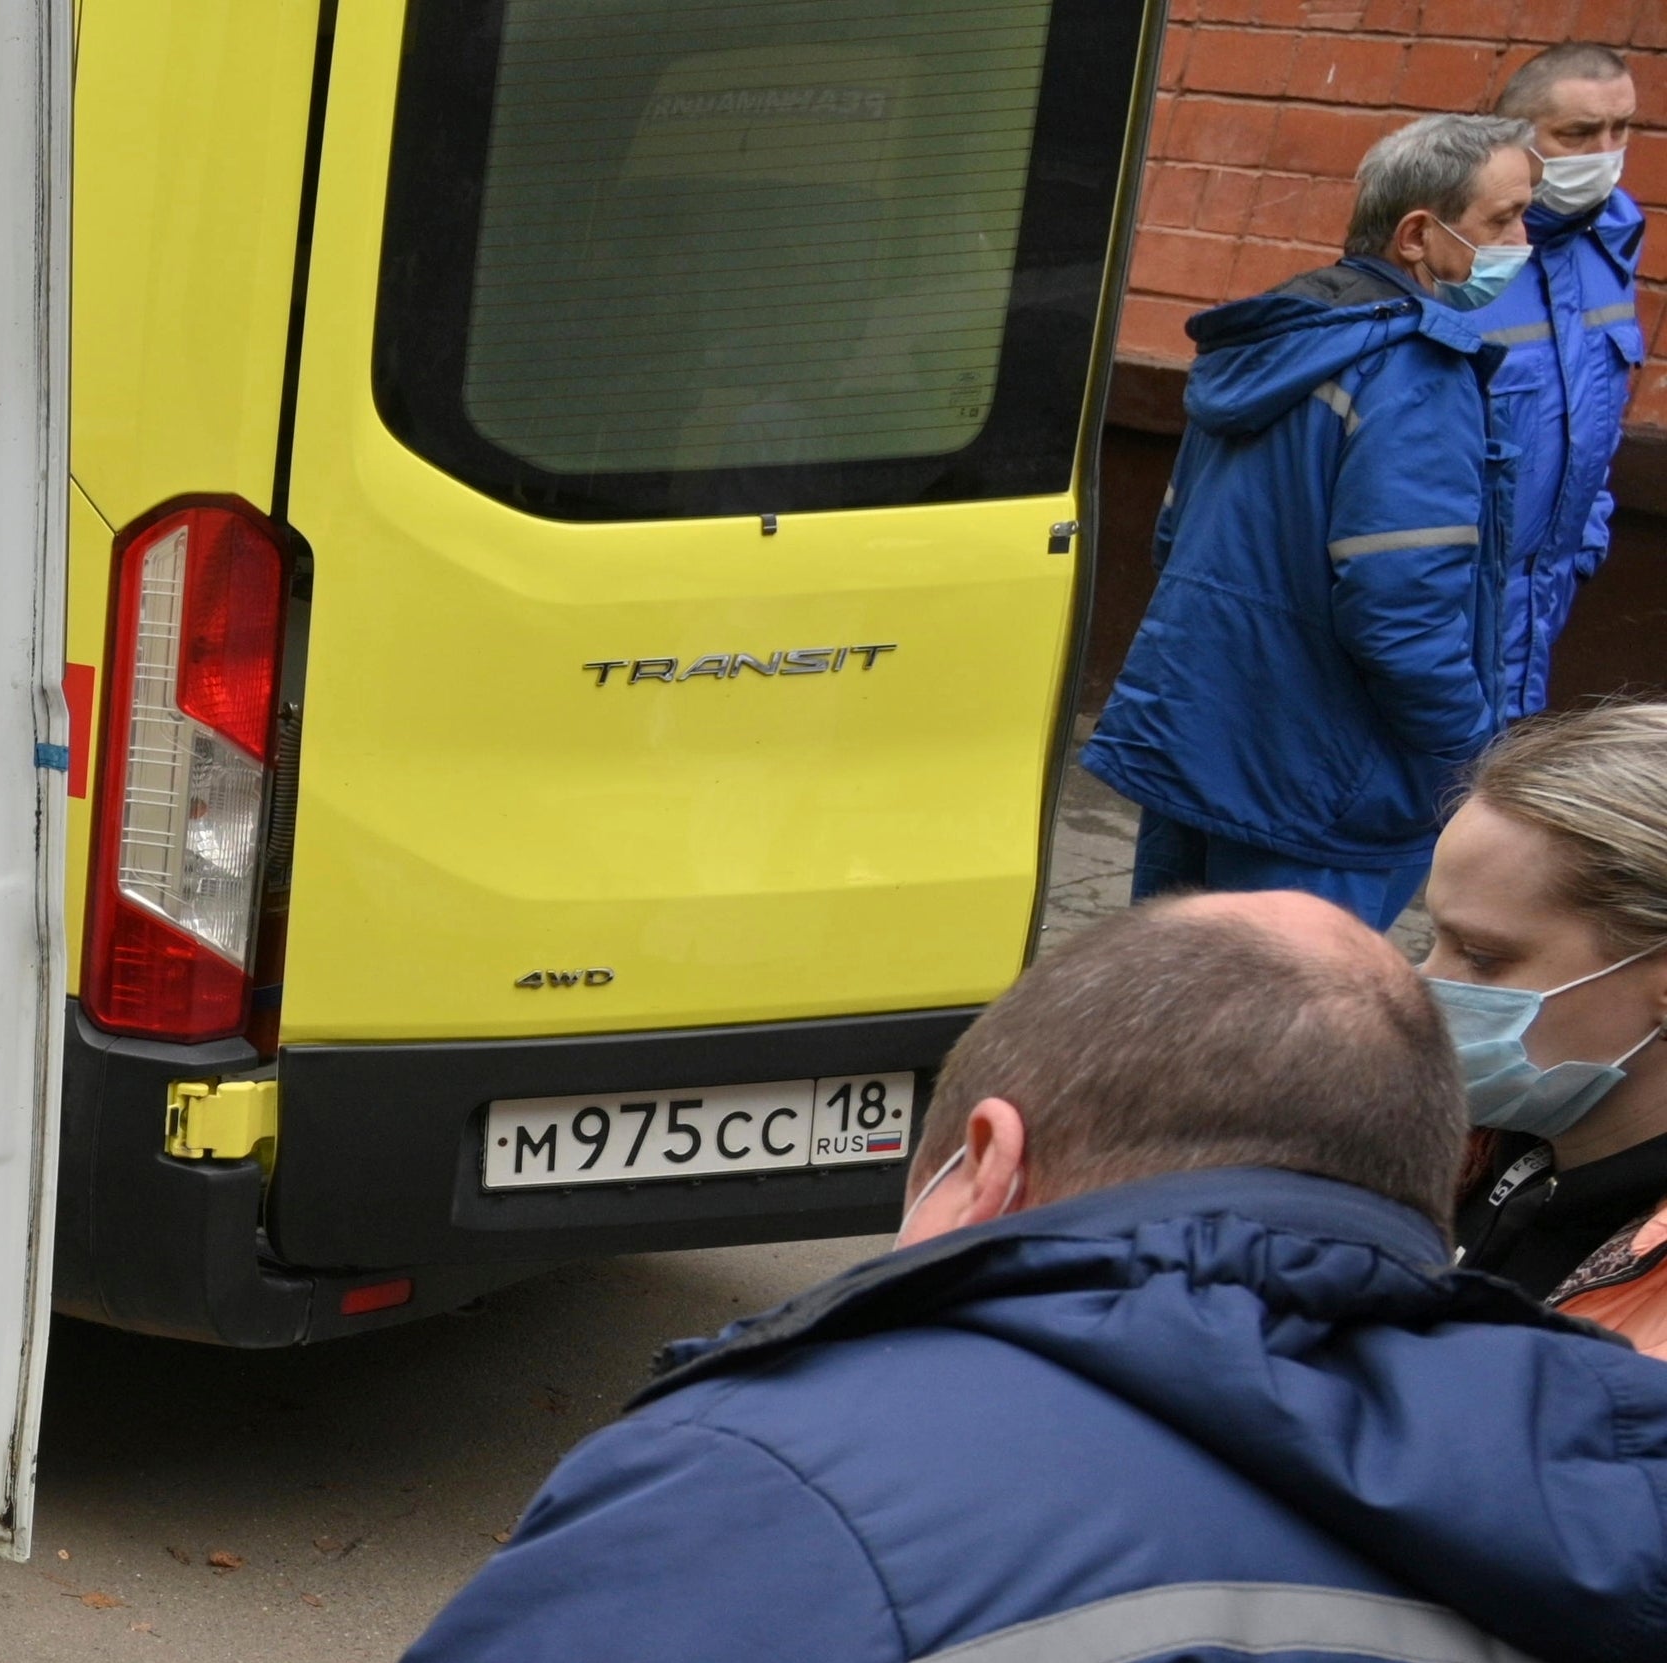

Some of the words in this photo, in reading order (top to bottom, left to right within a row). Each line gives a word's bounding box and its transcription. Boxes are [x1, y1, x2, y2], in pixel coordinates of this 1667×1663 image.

[584, 643, 898, 686] TRANSIT
[514, 966, 615, 989] 4WD
[826, 1079, 887, 1133] 18
[816, 1136, 865, 1156] RUS
